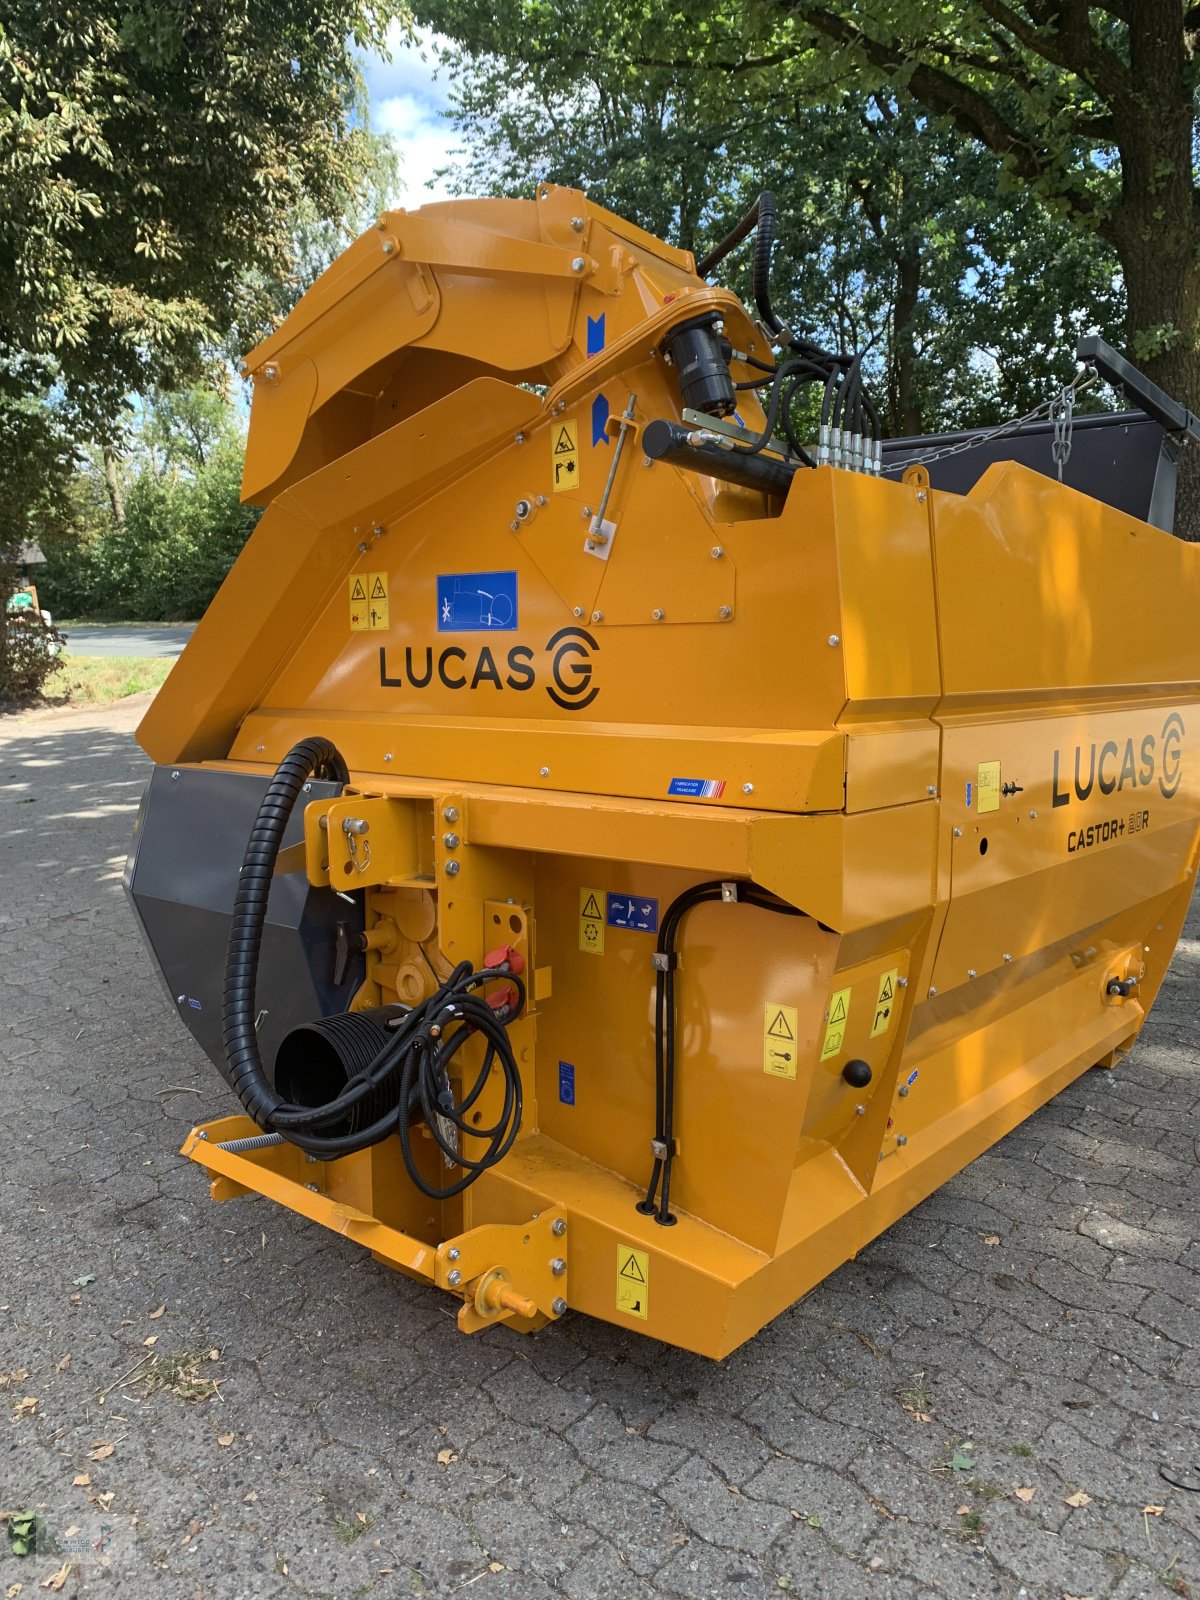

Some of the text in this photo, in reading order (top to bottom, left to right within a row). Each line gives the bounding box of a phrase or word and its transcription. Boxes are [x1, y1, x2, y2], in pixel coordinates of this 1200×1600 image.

[380, 645, 535, 691] LUCAS
[1052, 734, 1155, 808] LUCAS
[1068, 810, 1149, 853] CASTOR+ 20R
